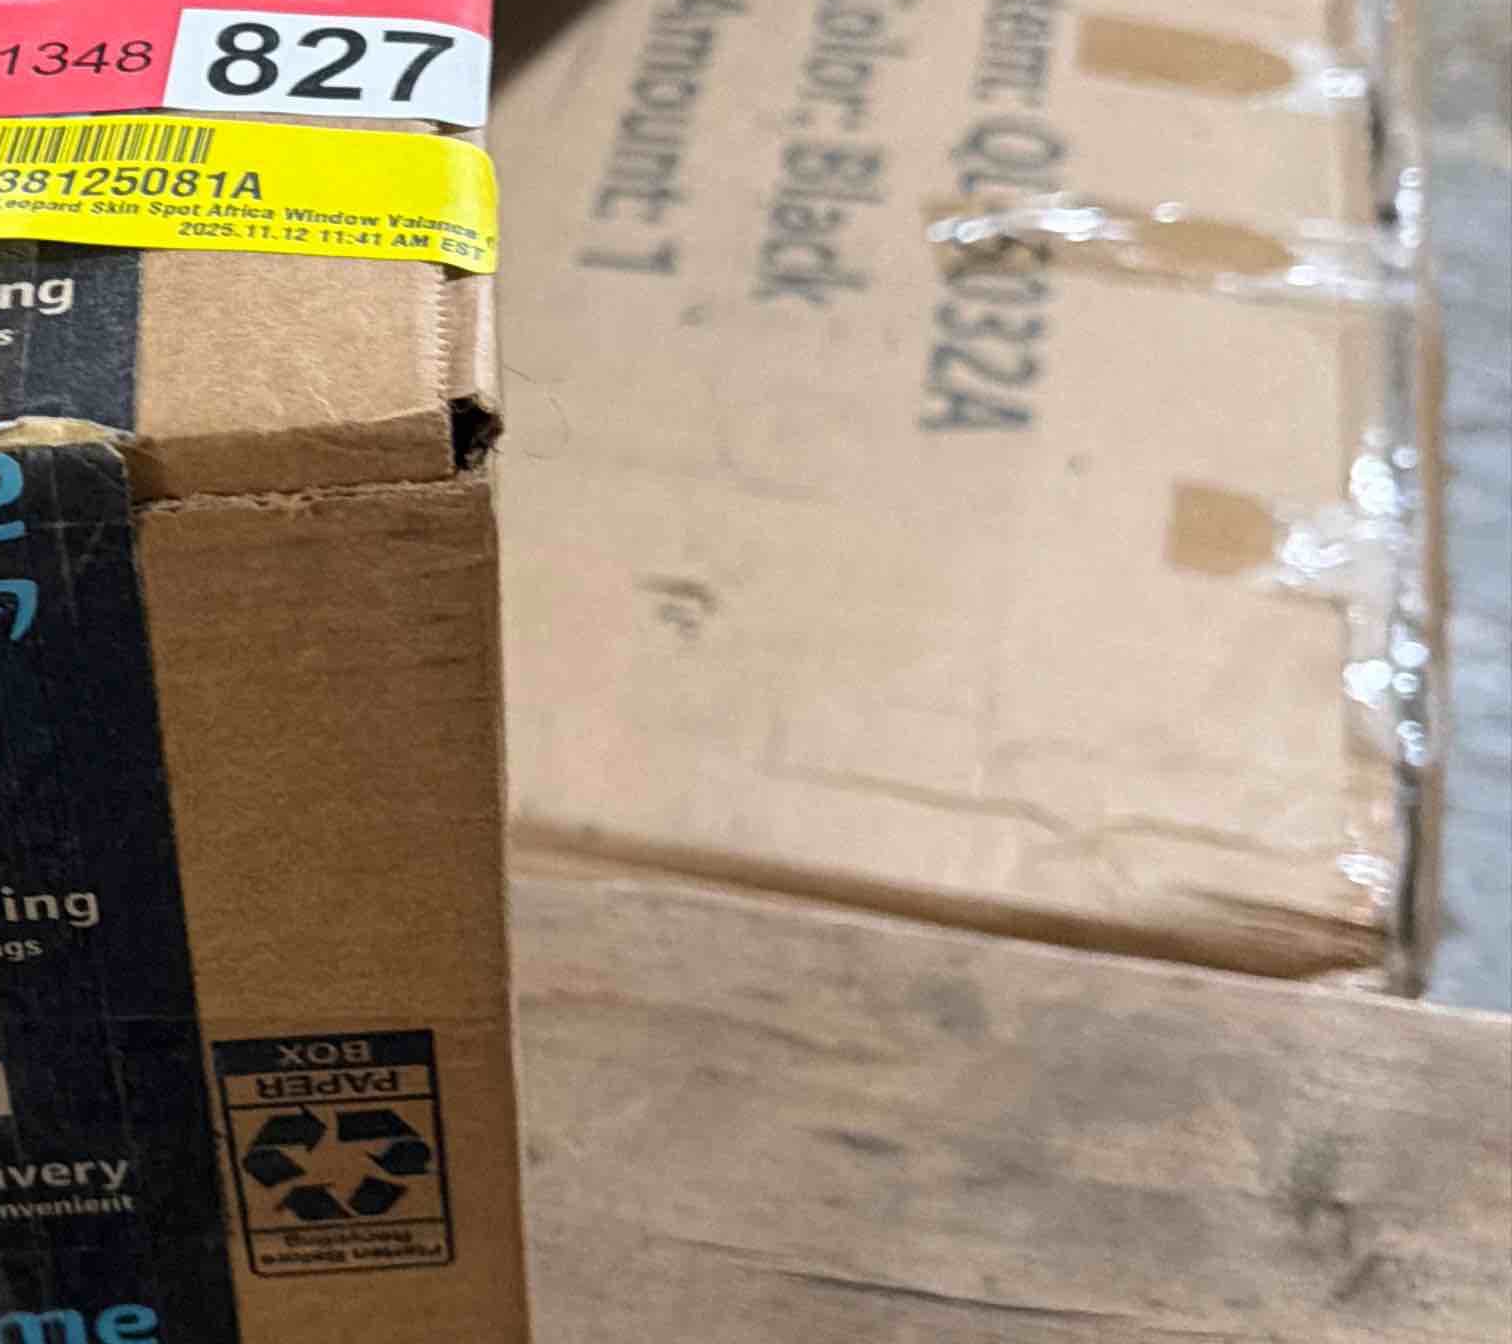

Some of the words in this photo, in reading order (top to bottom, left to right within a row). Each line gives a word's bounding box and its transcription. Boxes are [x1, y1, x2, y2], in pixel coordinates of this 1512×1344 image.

[206, 21, 456, 103] 827
[90, 199, 141, 216] Skin
[147, 200, 201, 218] Spot
[207, 202, 275, 221] Africa
[285, 207, 380, 228] Window
[755, 142, 882, 307] Black
[178, 221, 308, 244] 2025.11.12
[320, 229, 383, 247] 11:41
[390, 233, 430, 250] AM
[440, 238, 487, 262] EST
[577, 245, 678, 276] 1
[277, 1039, 372, 1067] BOX
[254, 1069, 399, 1100] PAPER
